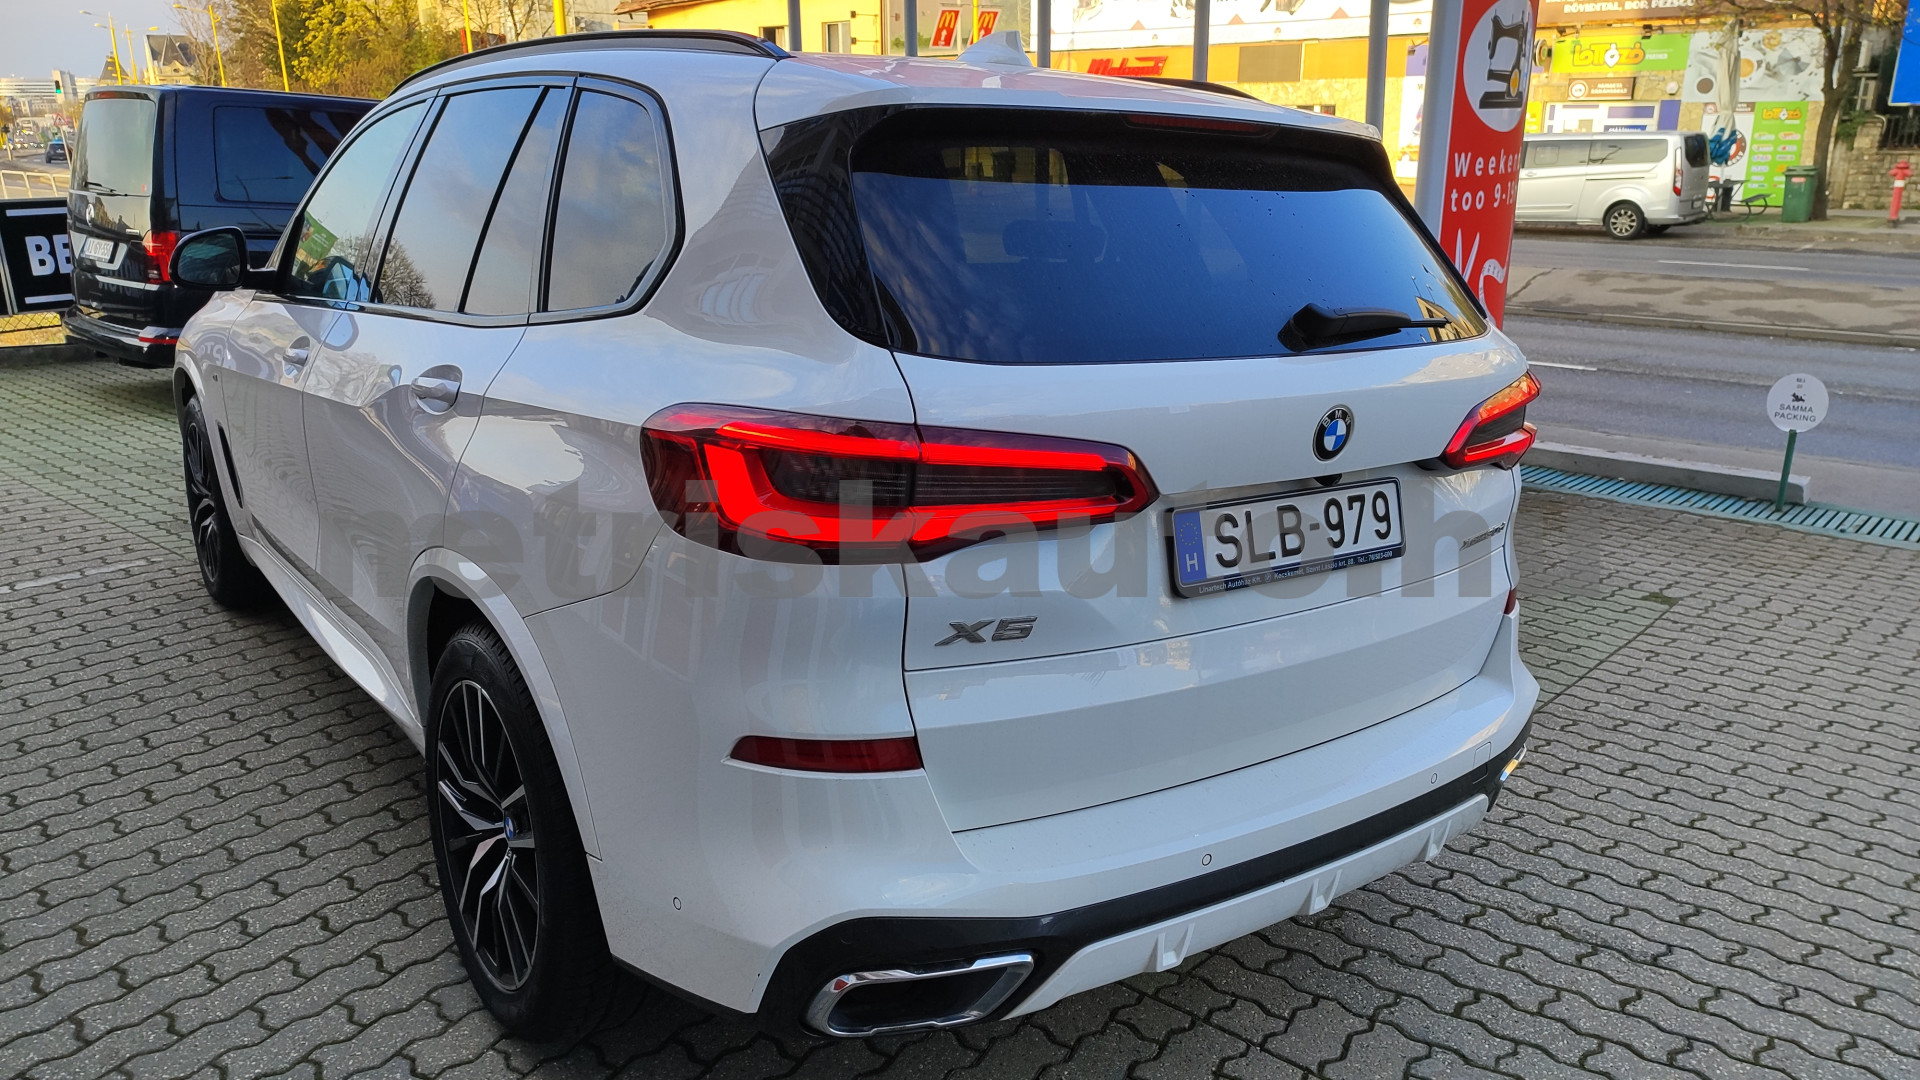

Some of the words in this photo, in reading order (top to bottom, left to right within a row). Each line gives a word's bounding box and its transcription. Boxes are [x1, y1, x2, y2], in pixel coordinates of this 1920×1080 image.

[1451, 188, 1485, 213] too
[1778, 403, 1814, 413] SAMMA
[1322, 409, 1351, 428] BMW
[1774, 411, 1817, 423] PACKING
[1185, 552, 1198, 573] H
[1214, 490, 1392, 568] SLB-979
[1198, 582, 1227, 594] Linartech
